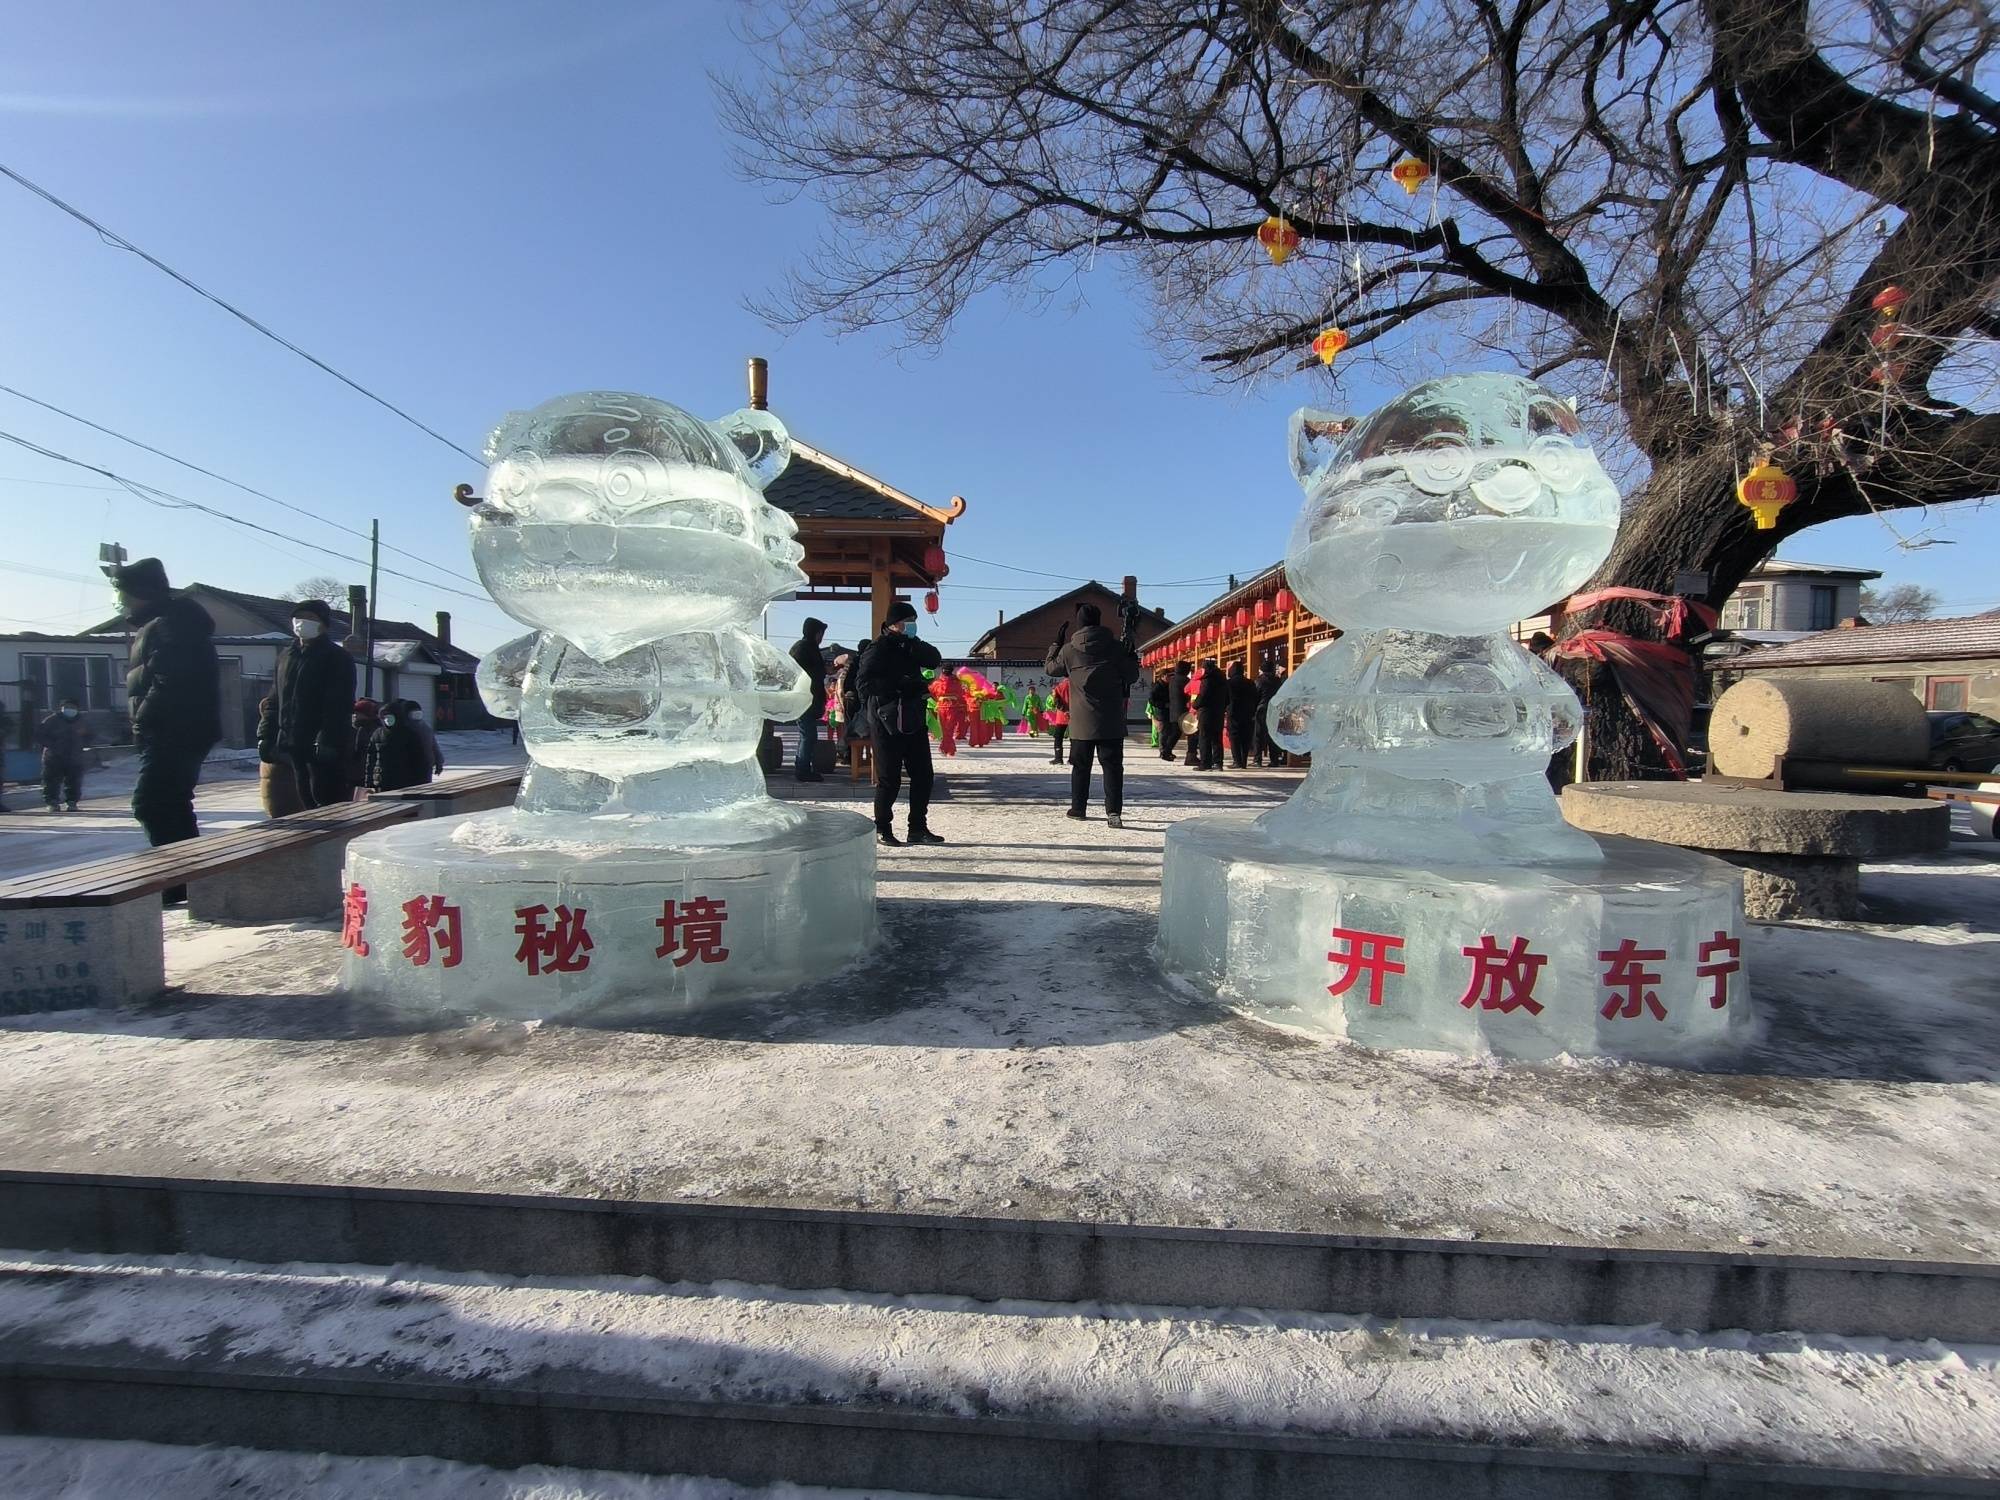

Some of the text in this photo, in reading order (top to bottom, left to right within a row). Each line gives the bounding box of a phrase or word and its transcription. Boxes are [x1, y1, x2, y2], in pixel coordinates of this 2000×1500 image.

[341, 882, 729, 976] 虎豹秘境
[1327, 926, 1740, 1021] 开放东宁
